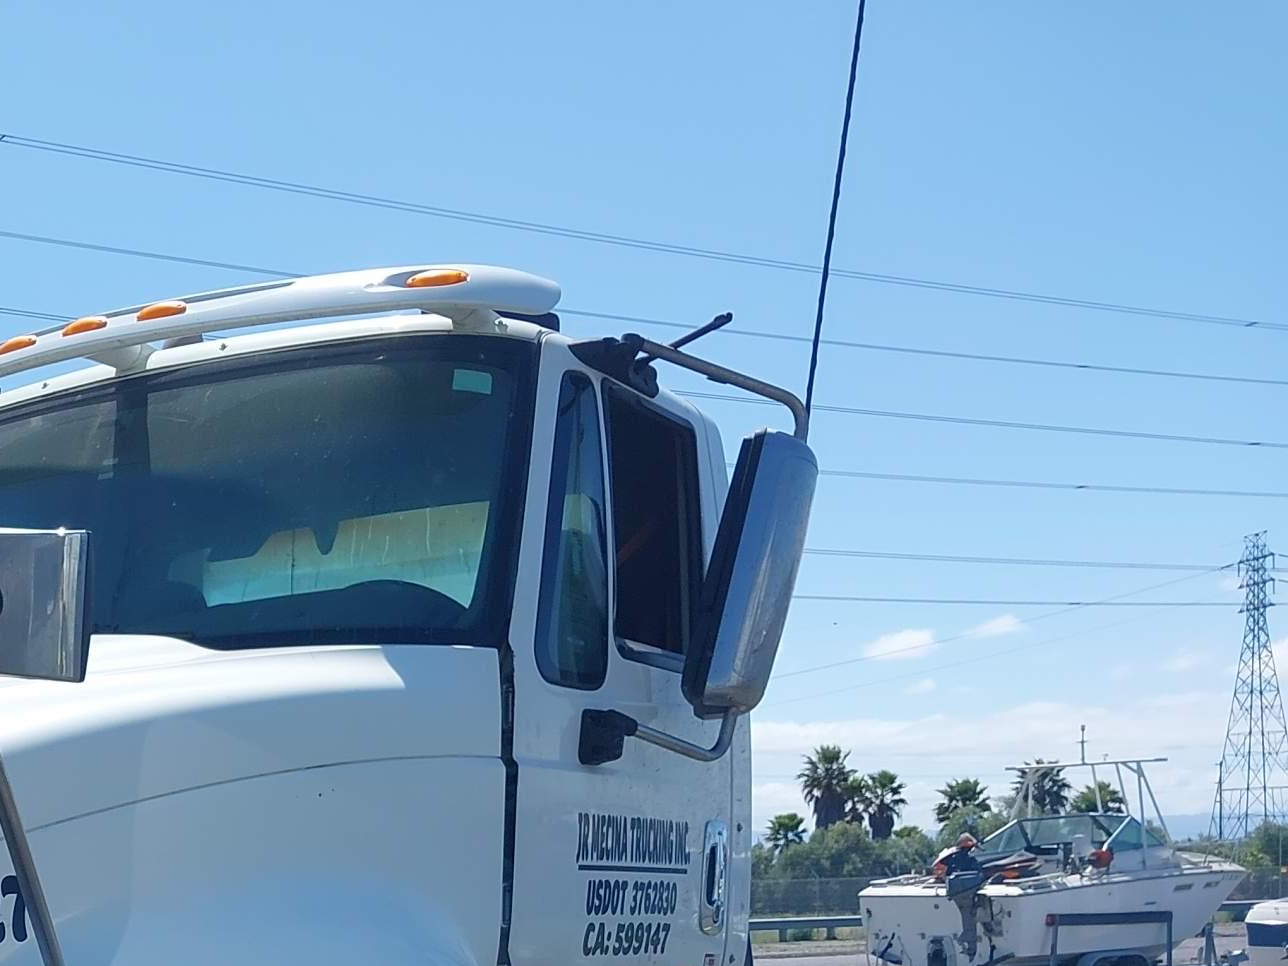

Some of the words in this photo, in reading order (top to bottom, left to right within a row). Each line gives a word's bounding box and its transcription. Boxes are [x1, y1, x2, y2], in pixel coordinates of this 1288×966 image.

[576, 812, 590, 864] JR
[630, 816, 674, 865] TRUCKING
[675, 821, 691, 866] INC.
[586, 879, 629, 916] USDOT
[630, 880, 678, 916] 3762830
